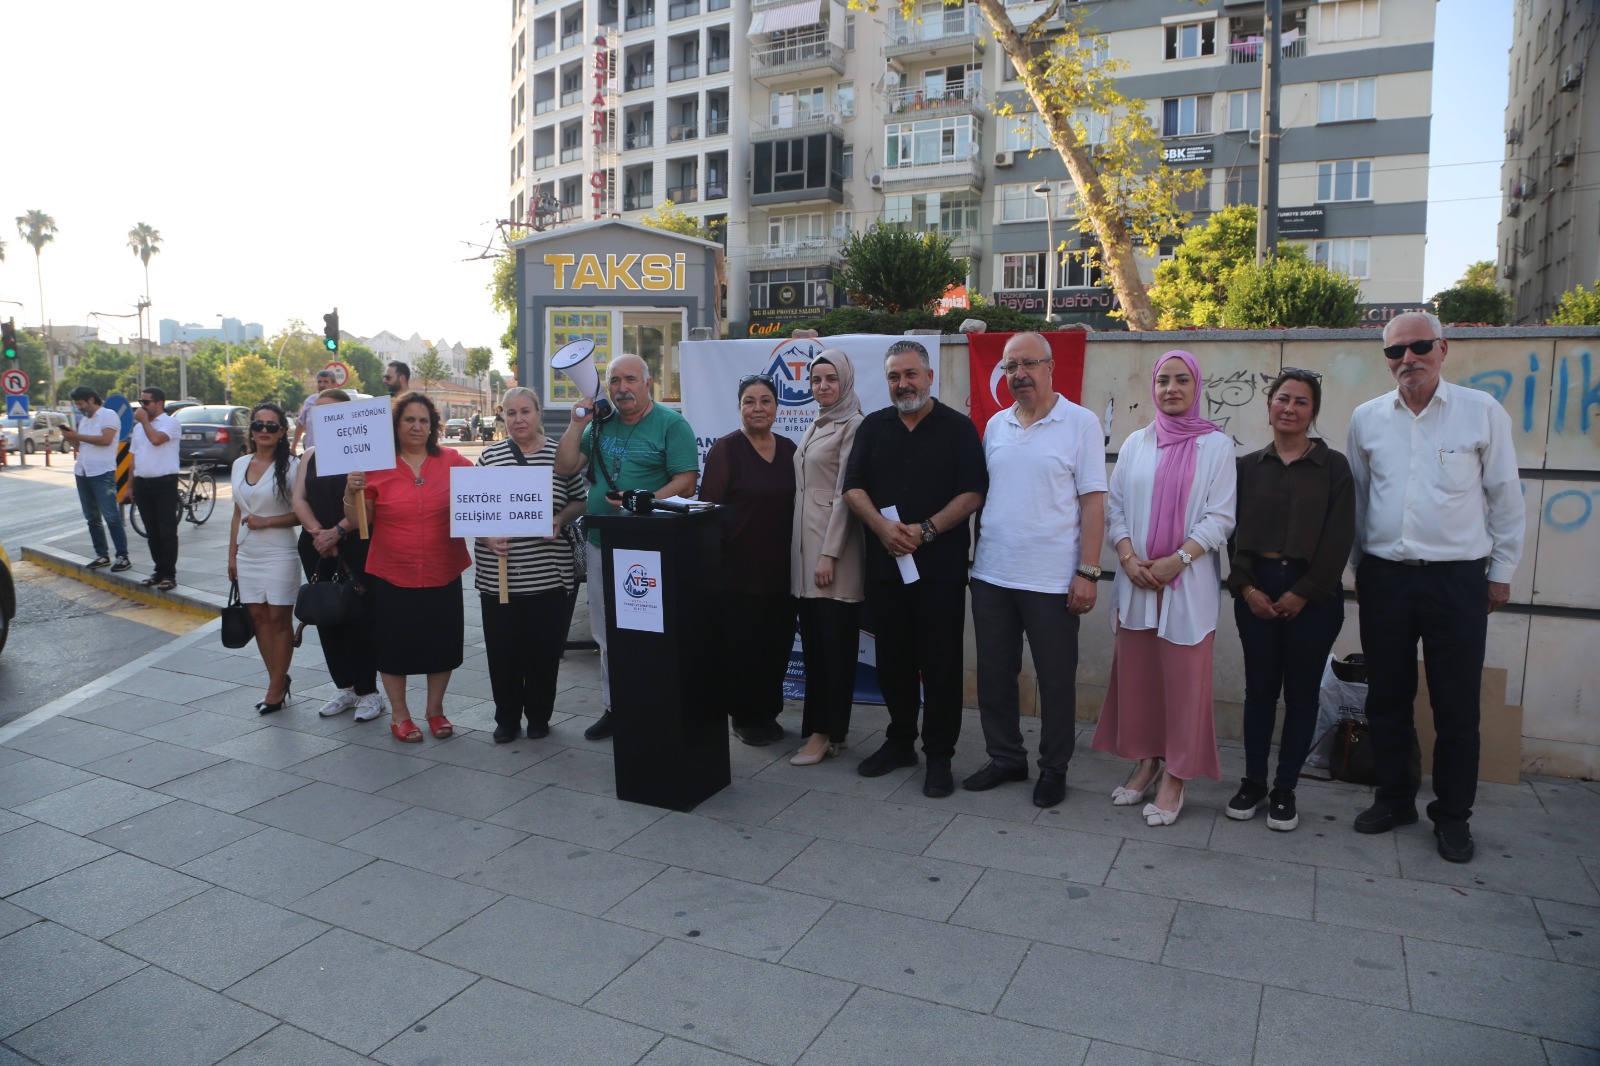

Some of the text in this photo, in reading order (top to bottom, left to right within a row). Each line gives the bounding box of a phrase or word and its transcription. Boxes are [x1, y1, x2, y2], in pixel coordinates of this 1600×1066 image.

[592, 52, 608, 145] START
[324, 407, 386, 422] EMLAK SEKTÖRÜNE
[336, 423, 368, 437] GEÇMİŞ
[343, 443, 371, 455] OLSUN
[456, 492, 542, 503] SEKTÖRE ENGEL
[455, 510, 544, 522] GELİŞİME DARBE
[625, 572, 657, 588] ATSB
